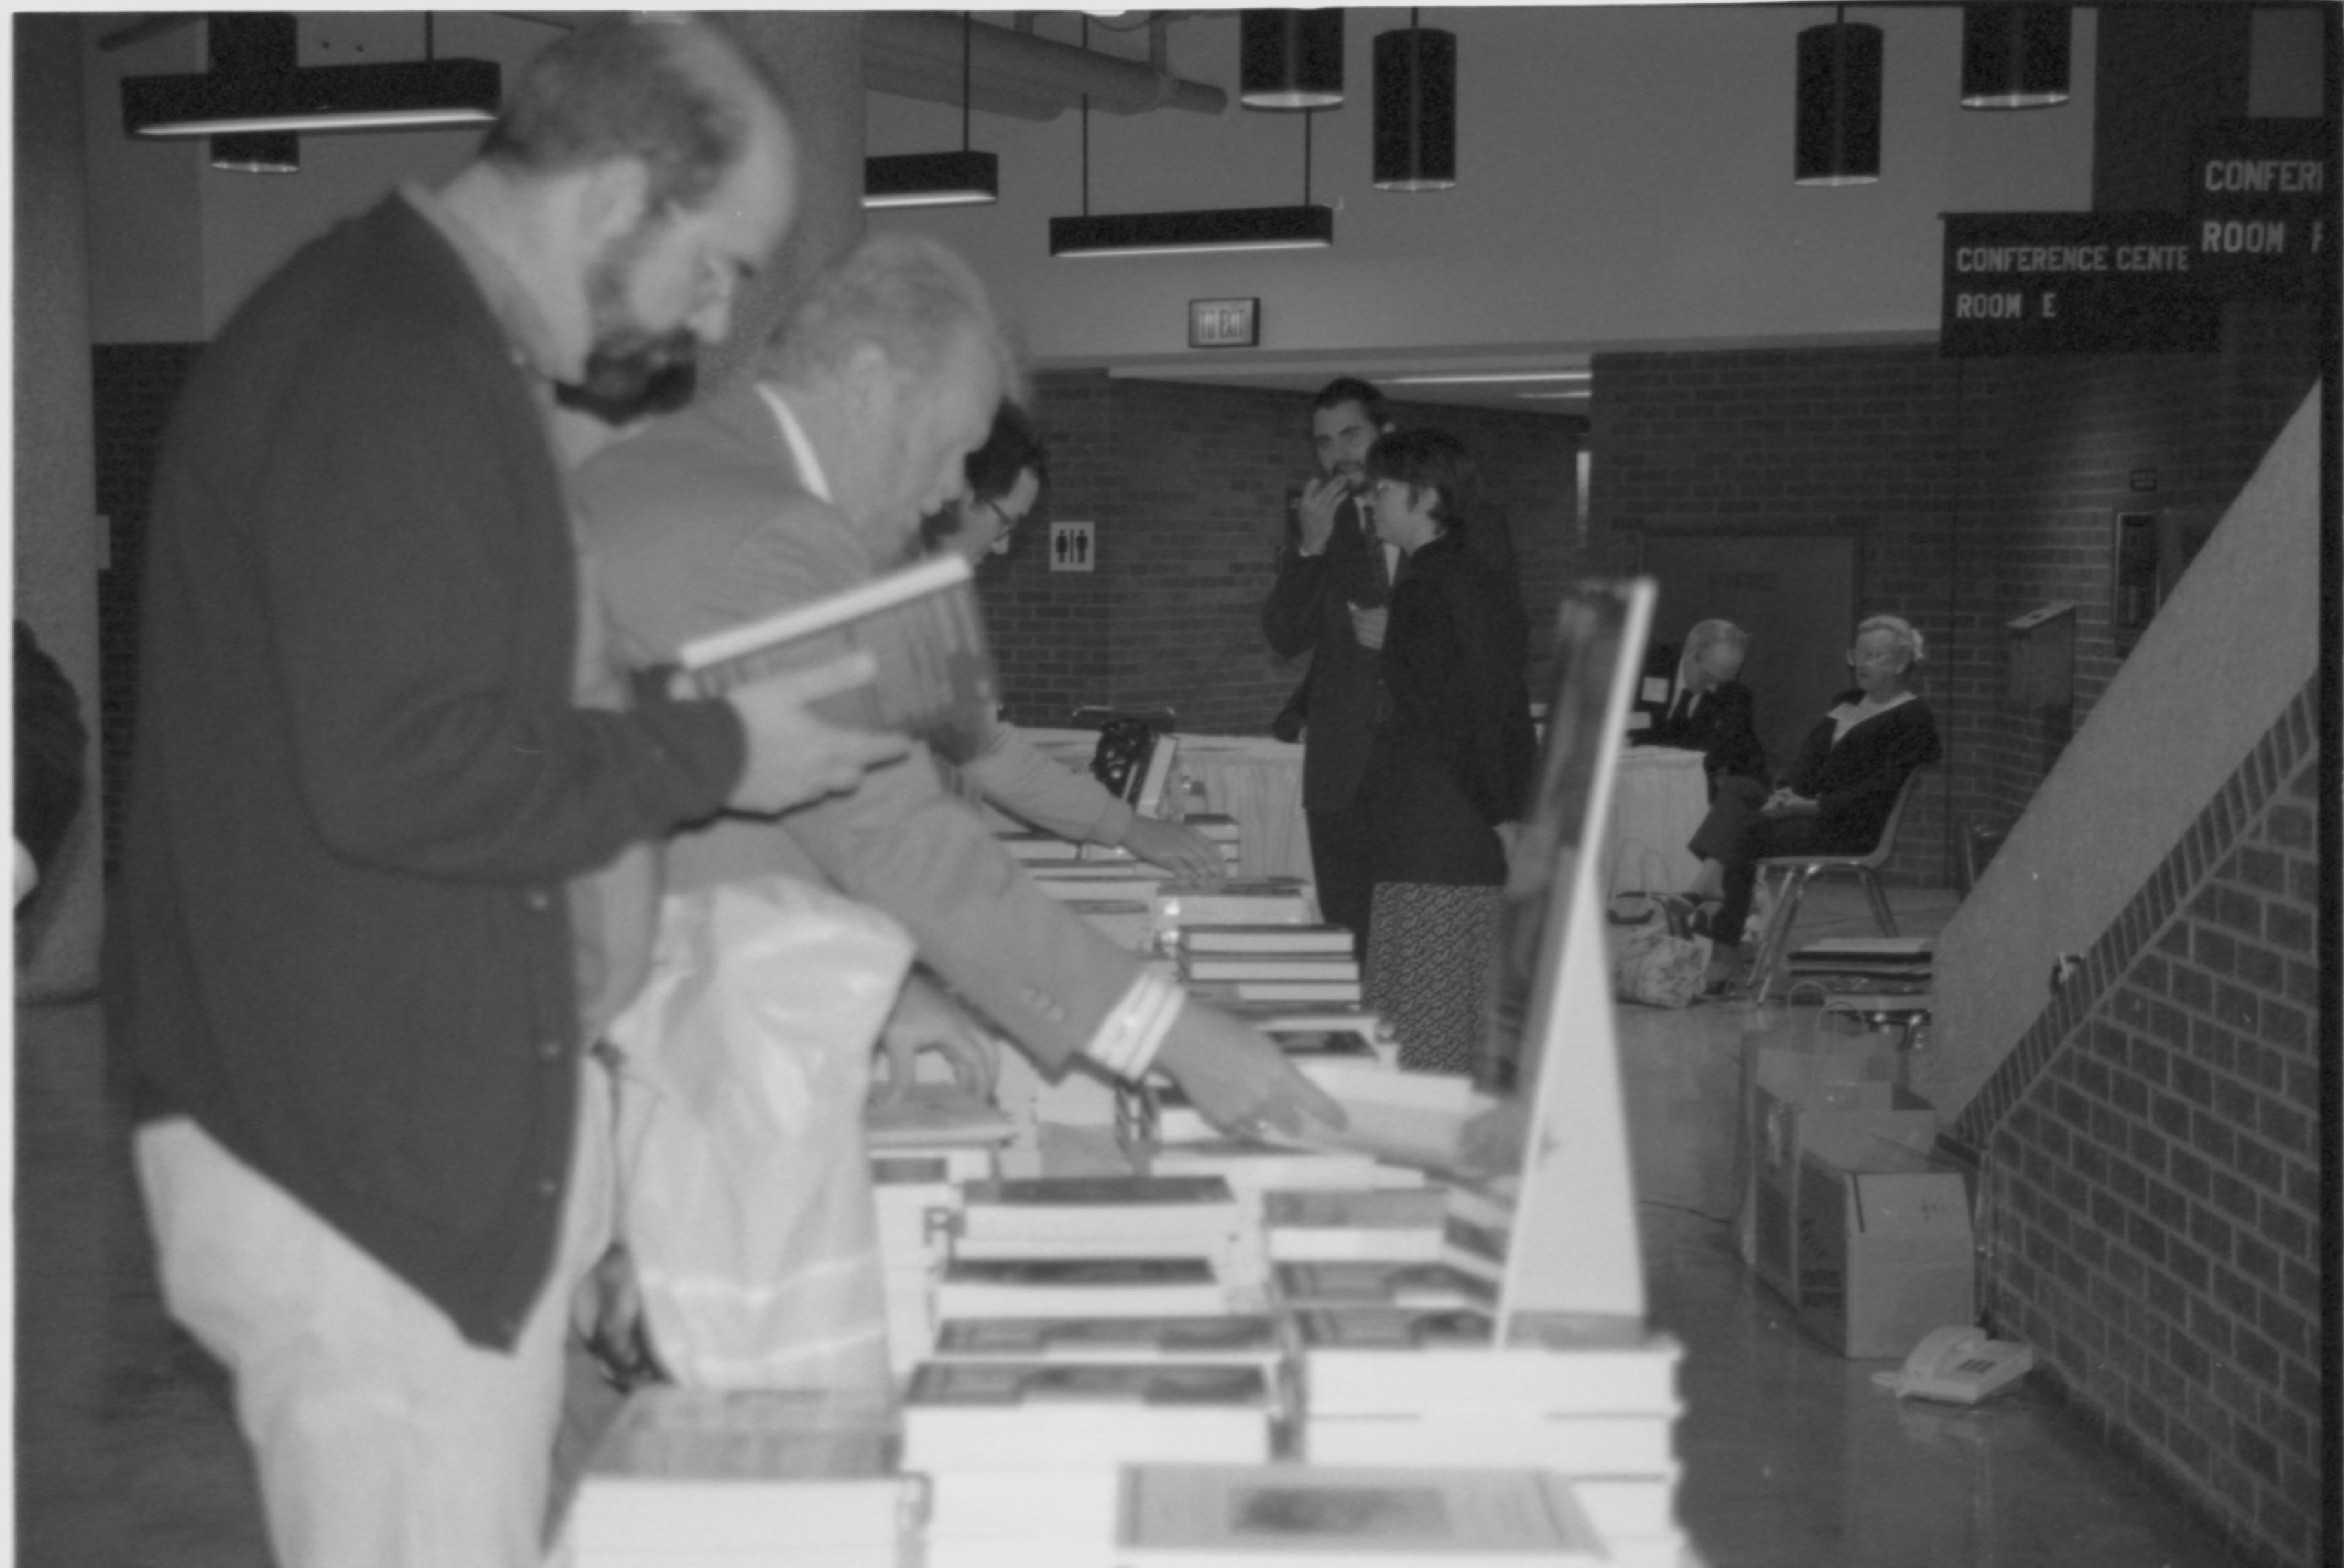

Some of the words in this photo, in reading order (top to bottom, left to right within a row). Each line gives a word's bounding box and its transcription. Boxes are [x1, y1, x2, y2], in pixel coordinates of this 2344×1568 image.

[2201, 221, 2285, 253] ROOM
[1956, 246, 2108, 272] CONFERENCE
[2116, 245, 2189, 272] CENTE
[1956, 293, 2022, 318] ROOM
[2042, 292, 2057, 318] E
